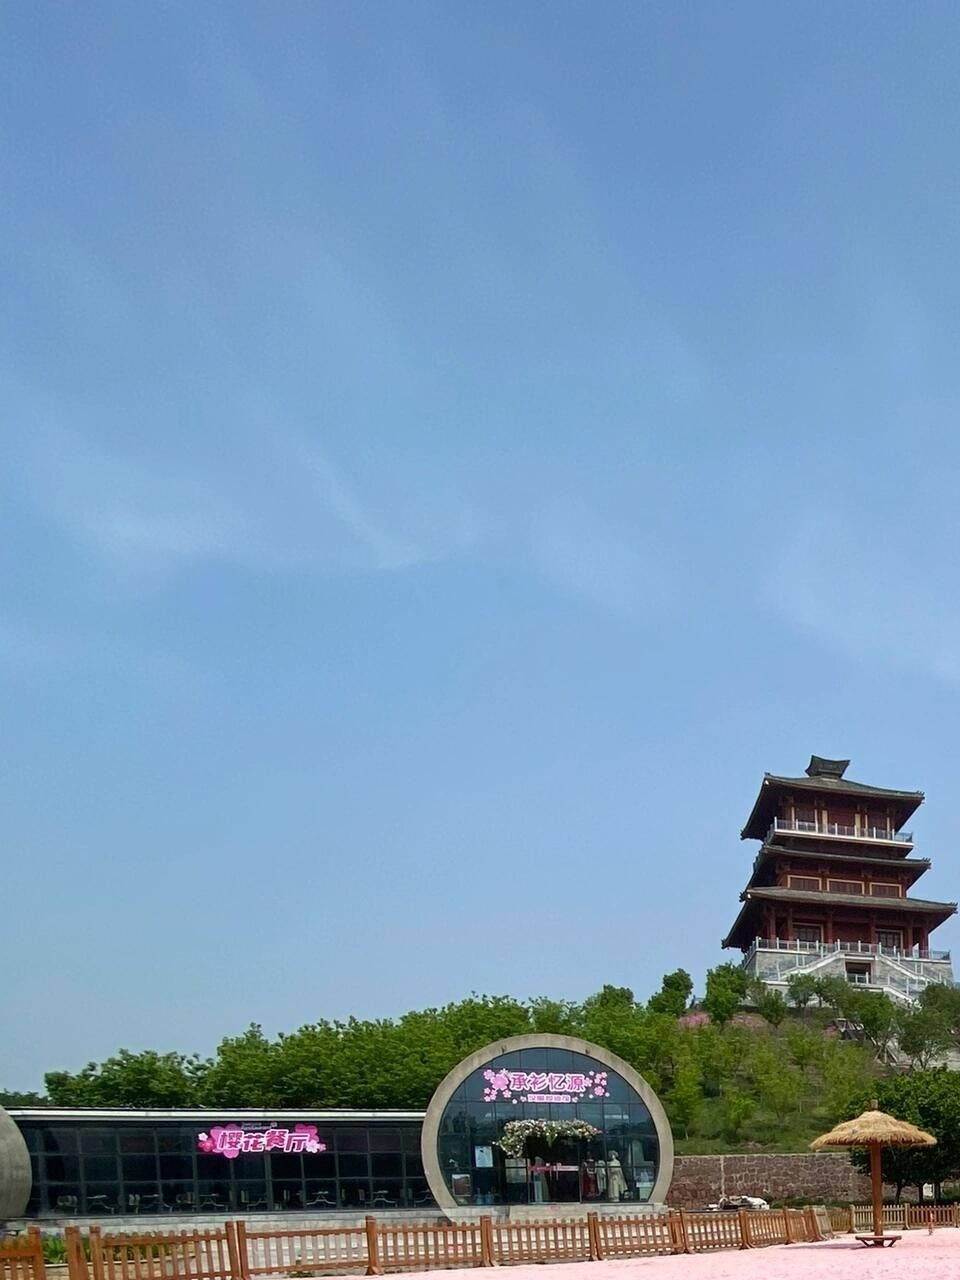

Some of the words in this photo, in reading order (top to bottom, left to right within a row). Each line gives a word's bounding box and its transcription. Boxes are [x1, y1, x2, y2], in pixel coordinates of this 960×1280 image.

[510, 1072, 585, 1092] 承衫忆源
[217, 1129, 309, 1152] 樱花餐厅
